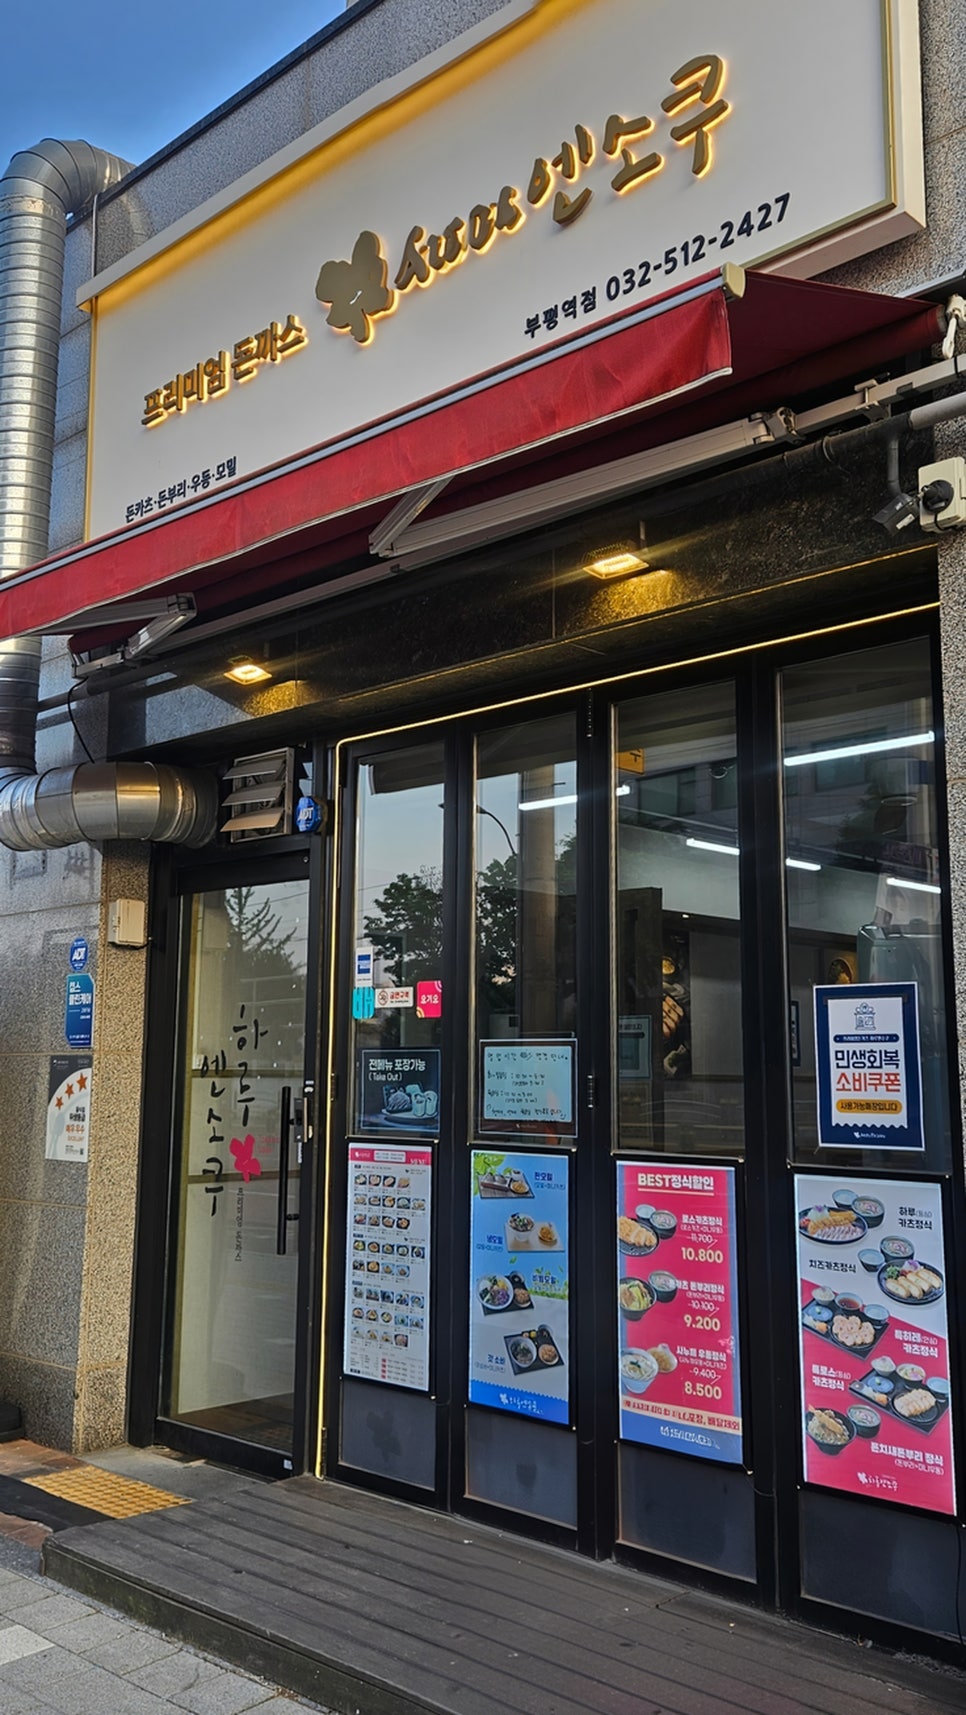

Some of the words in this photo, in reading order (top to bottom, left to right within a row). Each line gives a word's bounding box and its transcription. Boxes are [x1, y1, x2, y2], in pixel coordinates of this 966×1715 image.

[524, 286, 597, 338] 부평역점
[605, 192, 790, 301] 032-512-2427
[141, 350, 227, 427] 프리미엄
[231, 314, 307, 383] 돈까스
[72, 947, 86, 961] ADT
[233, 1004, 268, 1127] 하루
[368, 1059, 393, 1071] 전메뉴
[394, 1059, 426, 1071] 포장가능
[834, 1049, 900, 1069] 민생회복
[835, 1072, 901, 1092] 소비쿠폰
[201, 1049, 227, 1217] 엔소쿠
[637, 1173, 714, 1191] BEST정식할인
[898, 1218, 933, 1230] 카츠정식
[681, 1247, 723, 1263] 10.800
[809, 1259, 857, 1273] 치즈카츠정식
[684, 1314, 720, 1331] 9.200
[684, 1381, 722, 1399] 8.500
